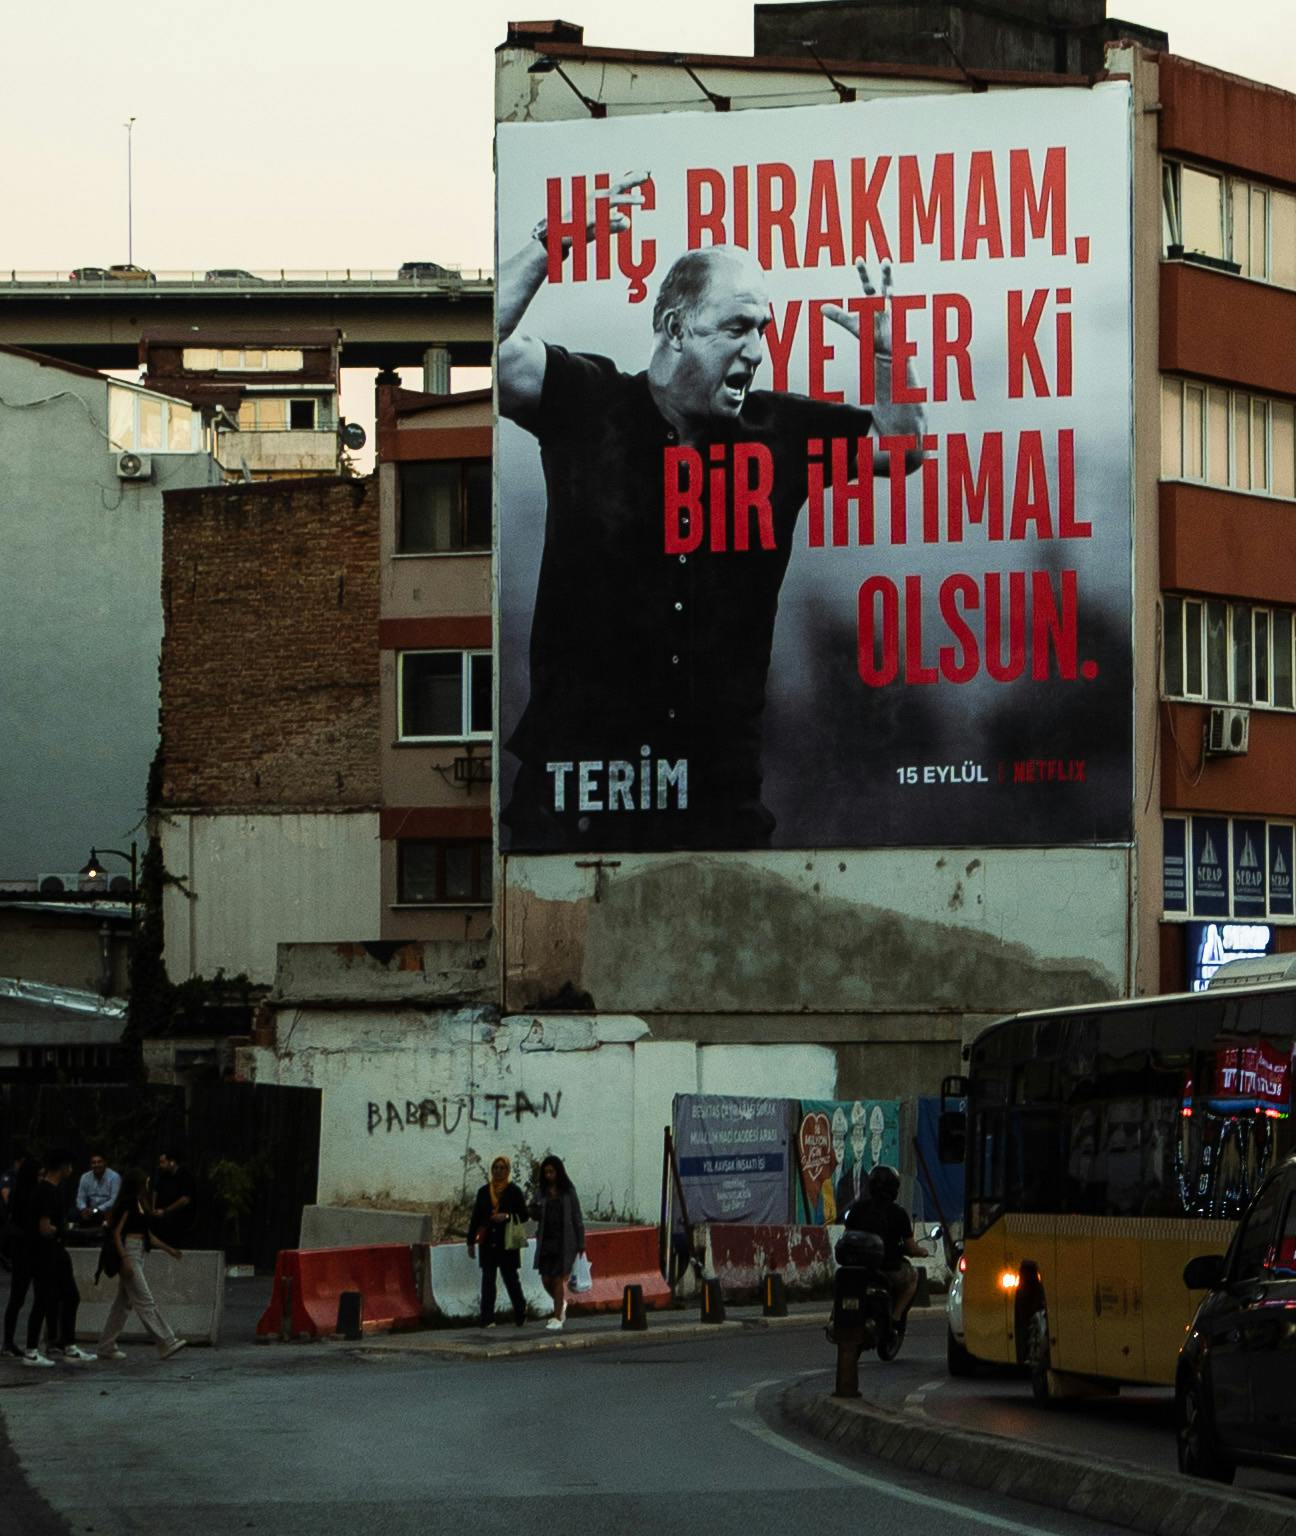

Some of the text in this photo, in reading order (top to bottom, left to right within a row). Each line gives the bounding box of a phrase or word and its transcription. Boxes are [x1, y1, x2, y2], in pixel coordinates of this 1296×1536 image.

[687, 147, 1091, 270] BIRAKMAM,
[764, 287, 1073, 405] YETER Kİ
[663, 428, 1092, 555] BİR İHTİMAL
[857, 569, 1099, 688] OLSUN.
[545, 744, 689, 812] TERİM
[896, 759, 1087, 784] 15 EYLÜL NETFLIX
